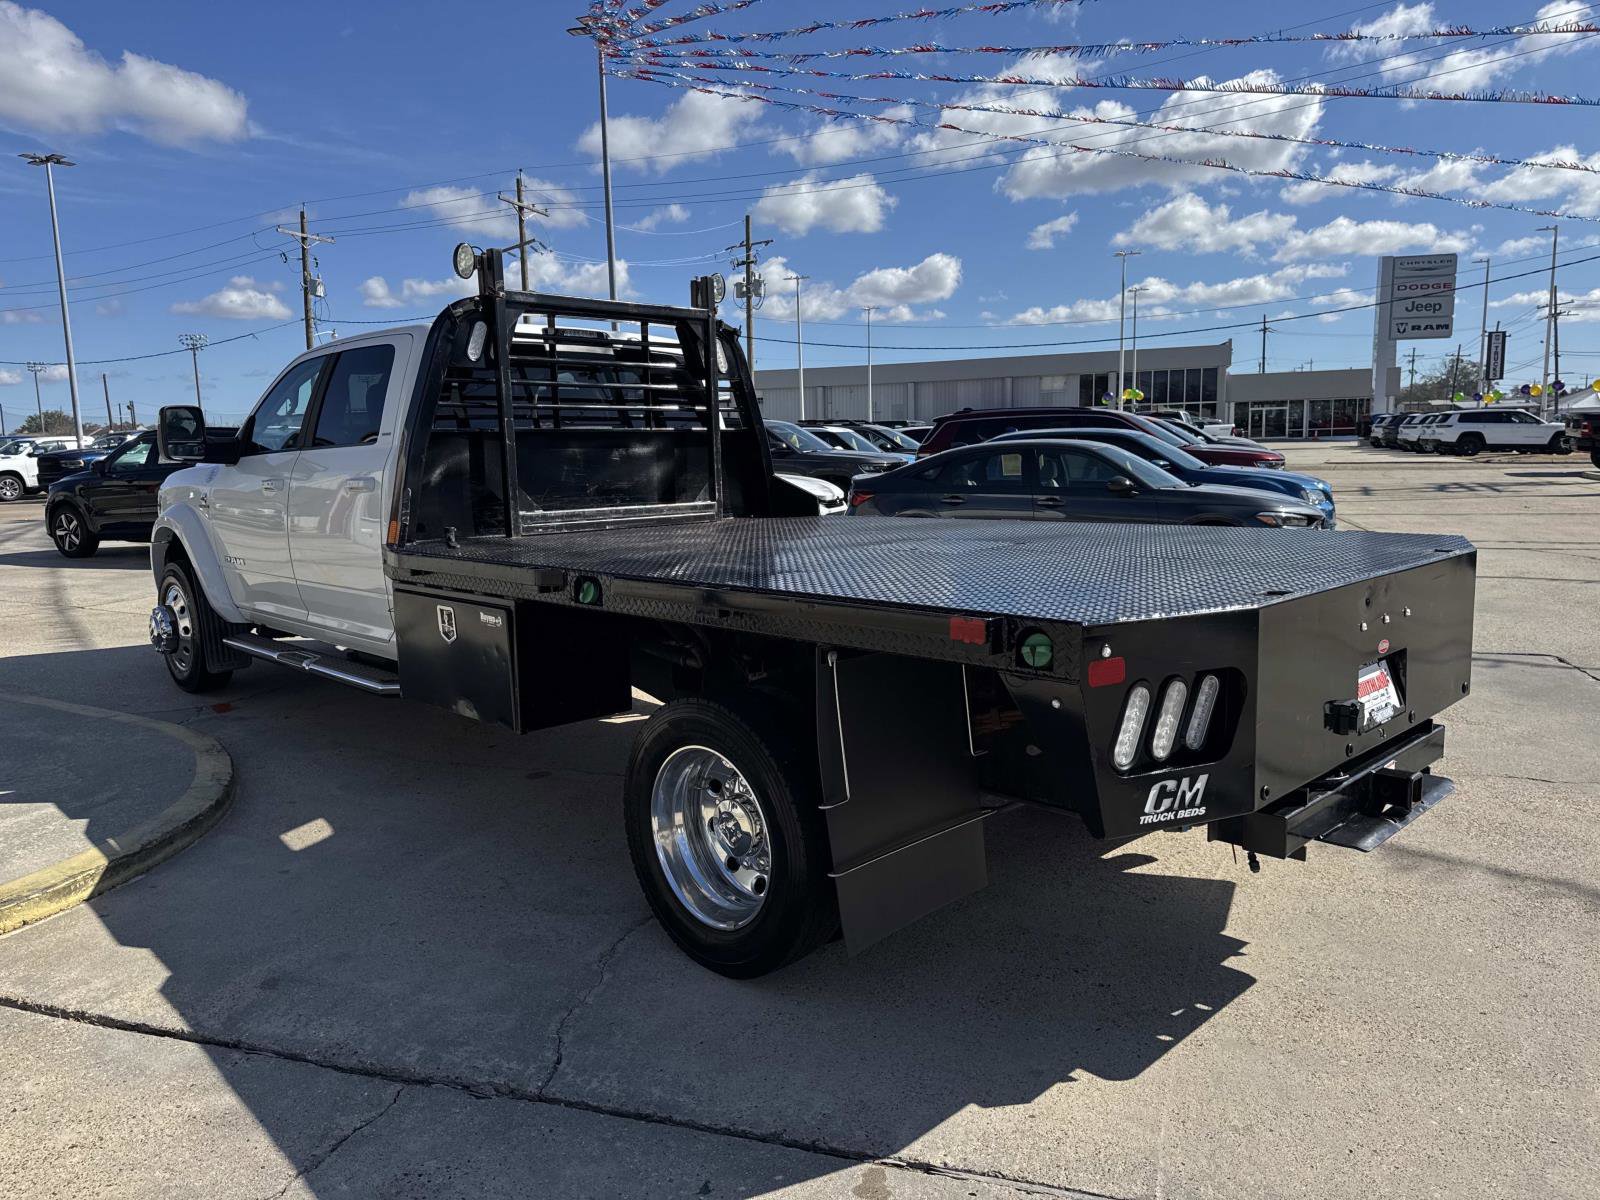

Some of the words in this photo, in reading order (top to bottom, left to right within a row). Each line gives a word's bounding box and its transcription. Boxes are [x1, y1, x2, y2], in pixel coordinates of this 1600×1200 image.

[1397, 282, 1453, 291] DODGE
[1405, 301, 1442, 313] Jeep
[1411, 323, 1450, 331] RAM
[224, 554, 247, 566] RAM
[1144, 773, 1209, 814] CM
[1139, 811, 1176, 825] TRUCK
[1177, 806, 1206, 819] BEDS
